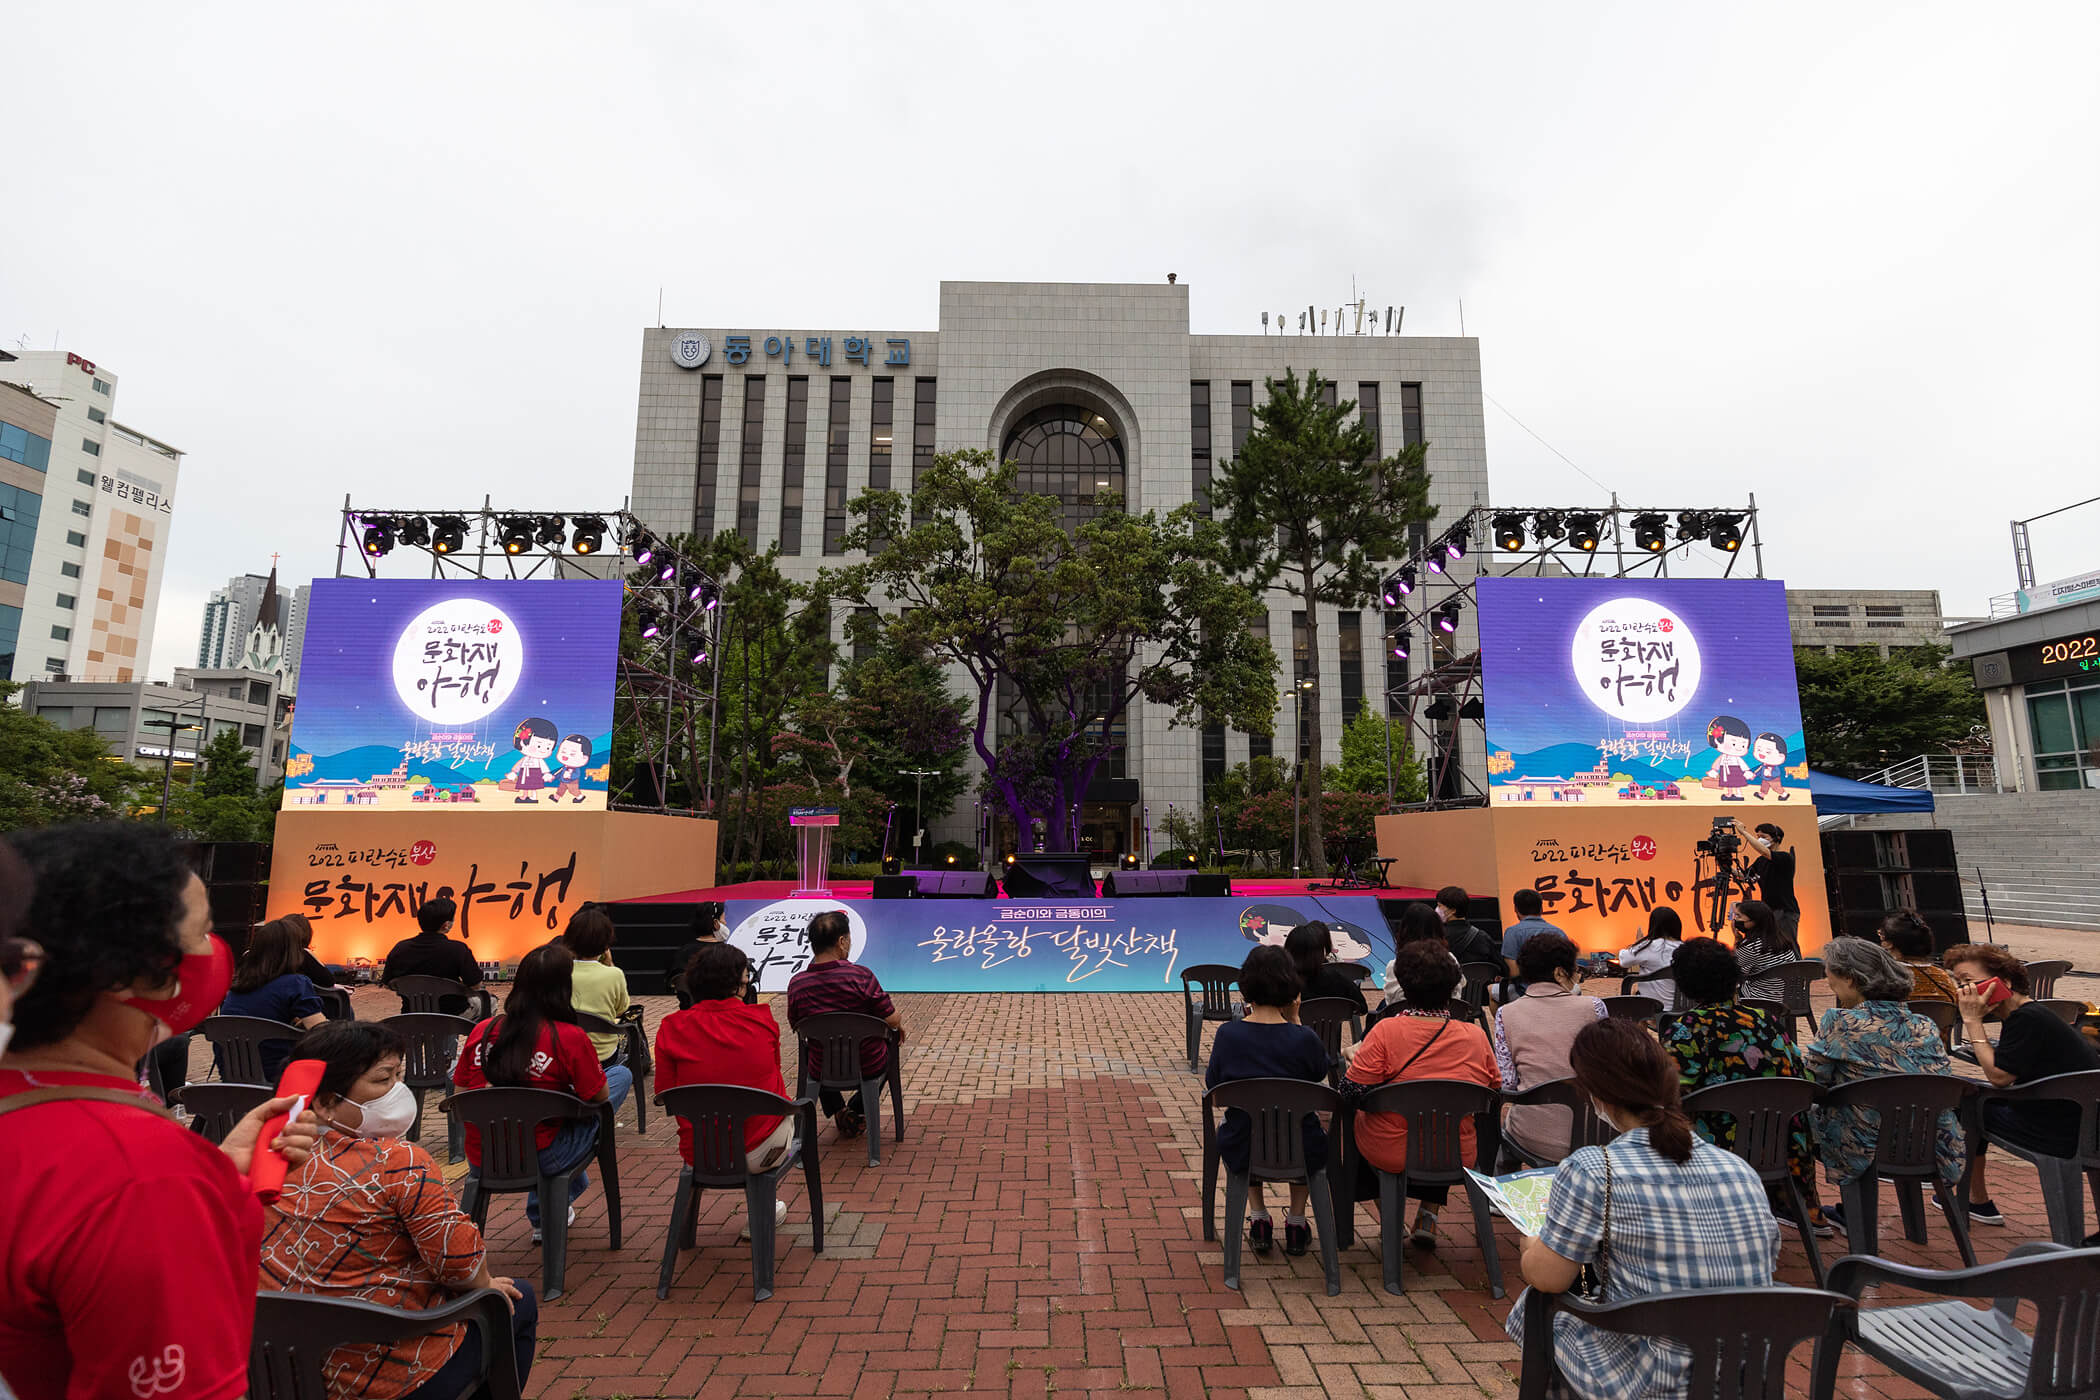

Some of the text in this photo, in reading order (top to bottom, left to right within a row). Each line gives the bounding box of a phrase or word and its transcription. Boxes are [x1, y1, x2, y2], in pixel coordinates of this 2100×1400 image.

[66, 351, 97, 376] PC
[722, 335, 911, 367] 동아대학교
[422, 637, 499, 666] 문화재
[1600, 636, 1674, 665] 문화재
[2041, 637, 2099, 665] 2022
[416, 659, 501, 709] 야행
[1600, 657, 1680, 707] 야행
[308, 845, 438, 870] 2022 피란수도 부산
[1531, 838, 1657, 865] 2022 피란수도 부산
[302, 873, 429, 923] 문화재
[1534, 869, 1657, 918] 문화재
[1000, 908, 1107, 920] 금순이와 금동이의
[753, 923, 811, 947] 문화
[1049, 923, 1179, 985] 달빛산책
